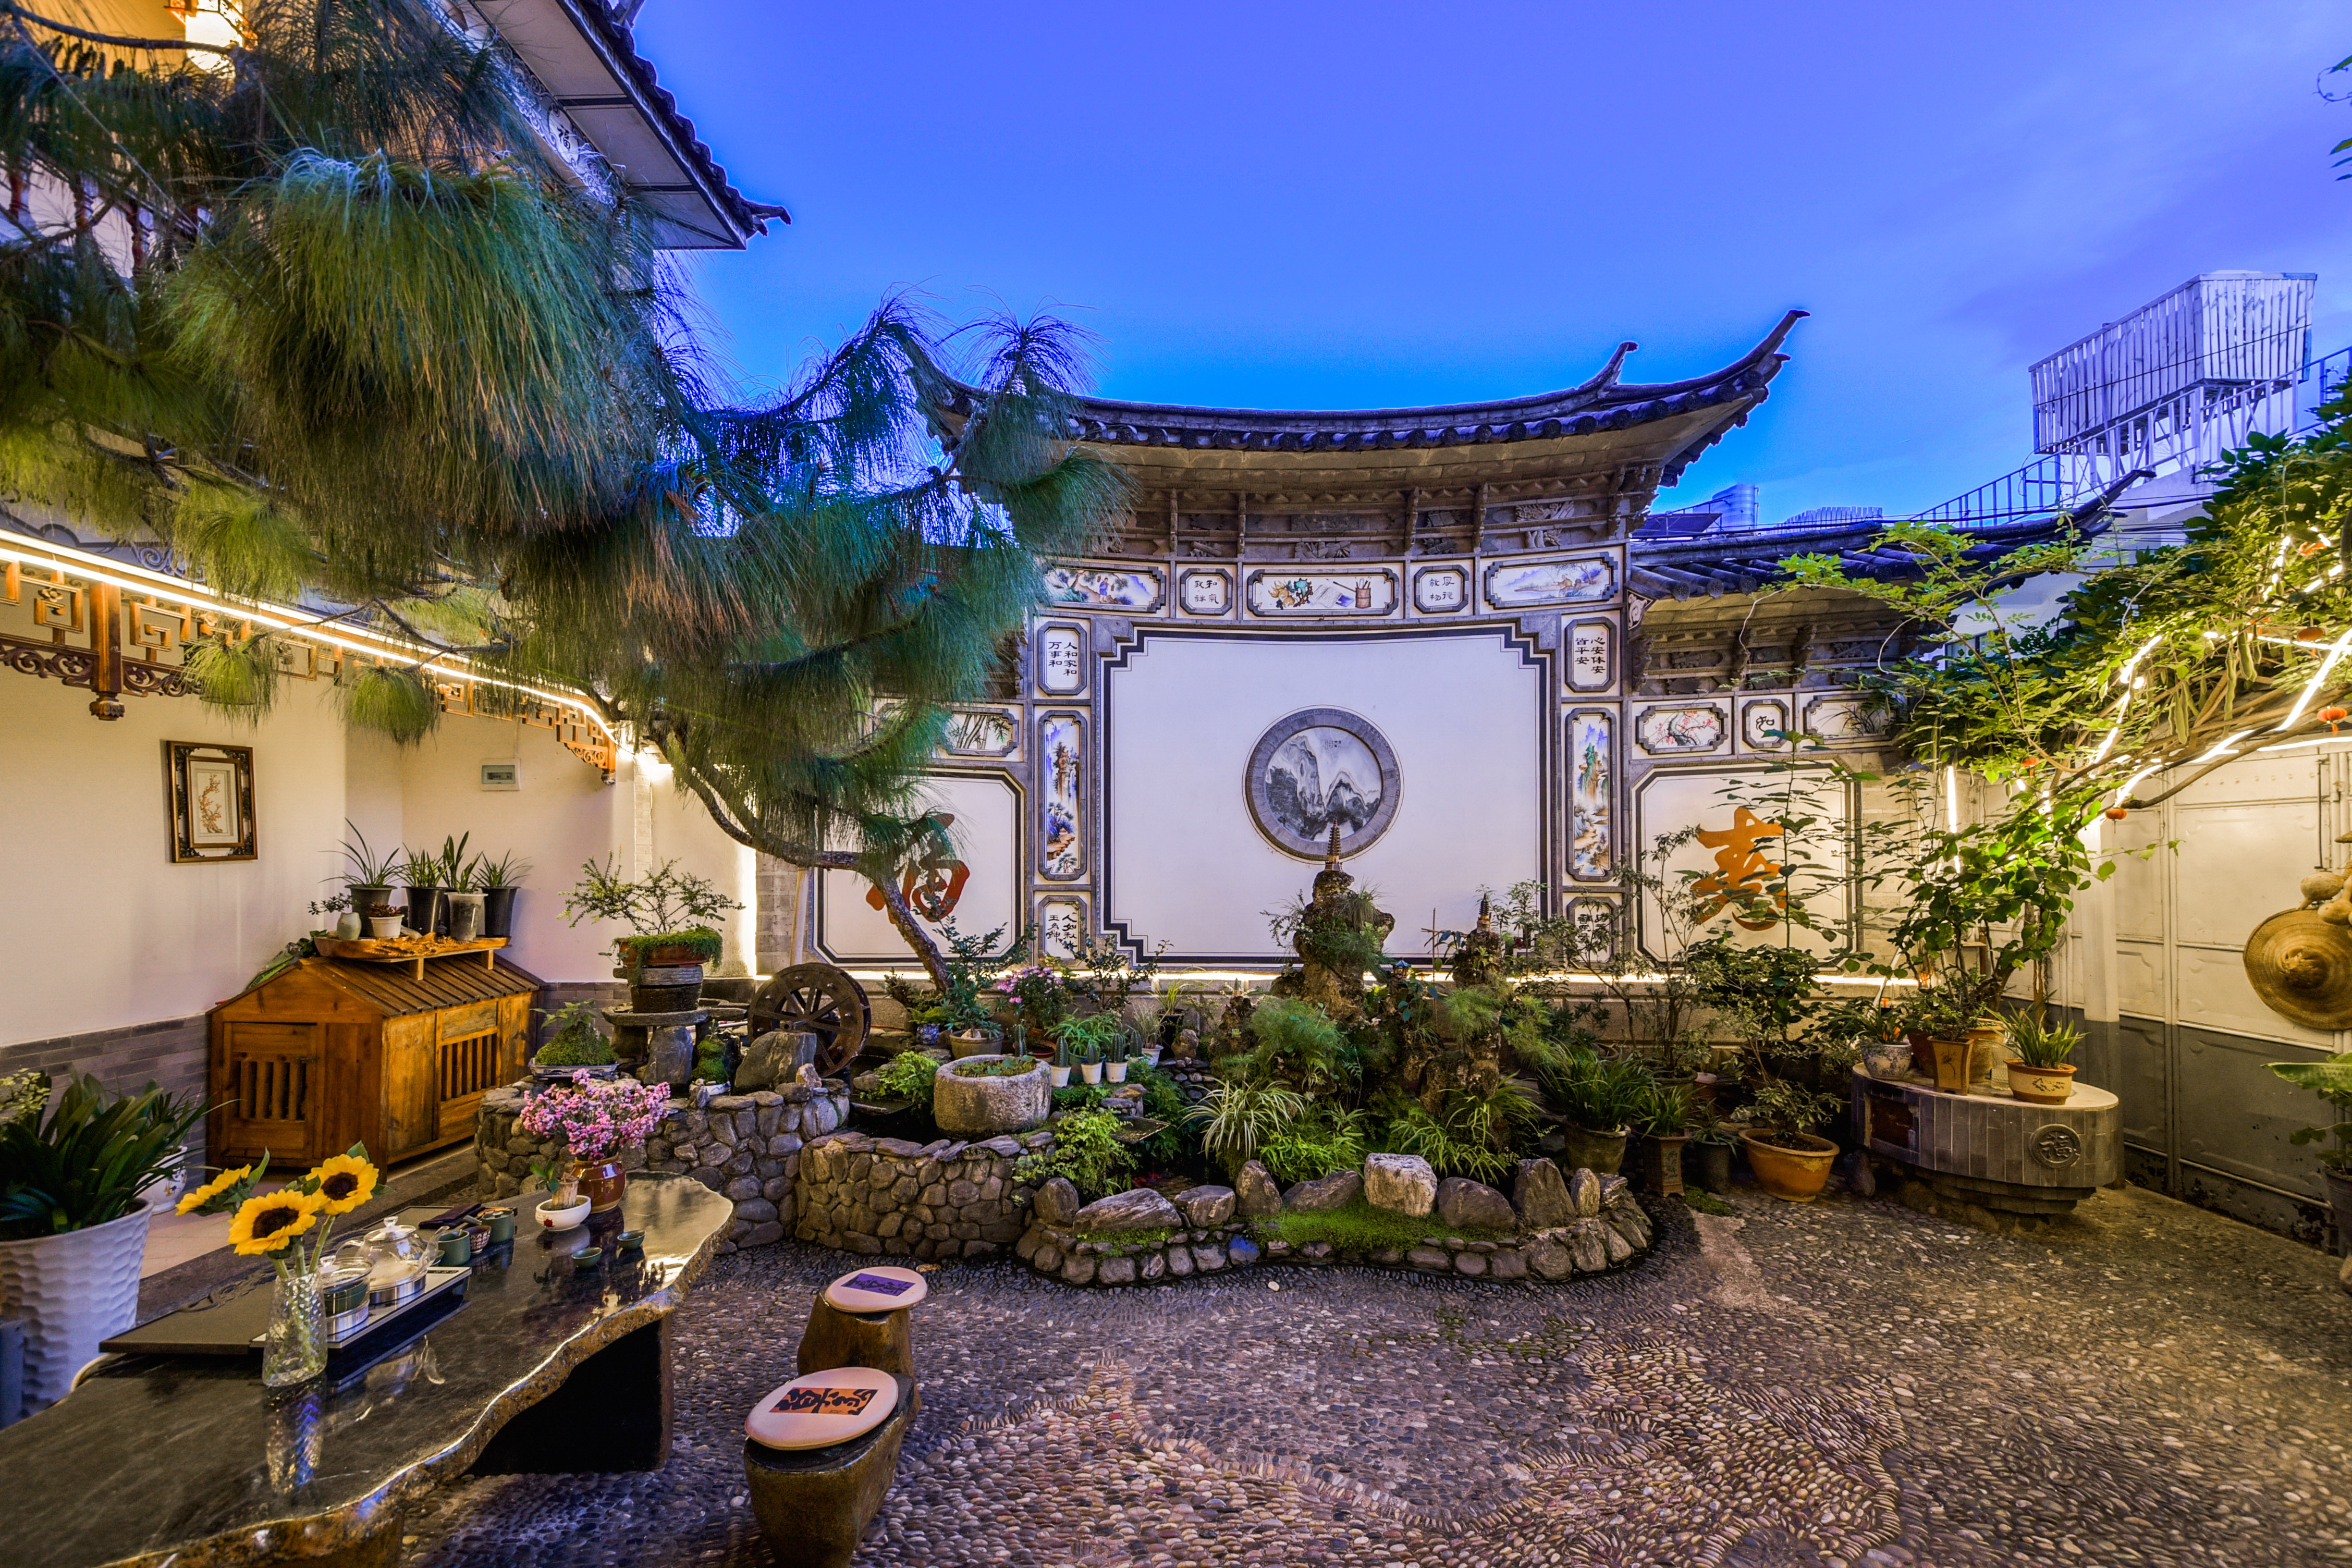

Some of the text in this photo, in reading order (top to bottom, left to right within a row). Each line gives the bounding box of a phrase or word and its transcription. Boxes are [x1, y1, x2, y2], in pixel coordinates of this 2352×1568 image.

[1048, 642, 1062, 667] 万事和
[1063, 642, 1077, 676] 人和家和
[1575, 638, 1589, 665] 皆平安
[1590, 637, 1606, 673] 心安体安
